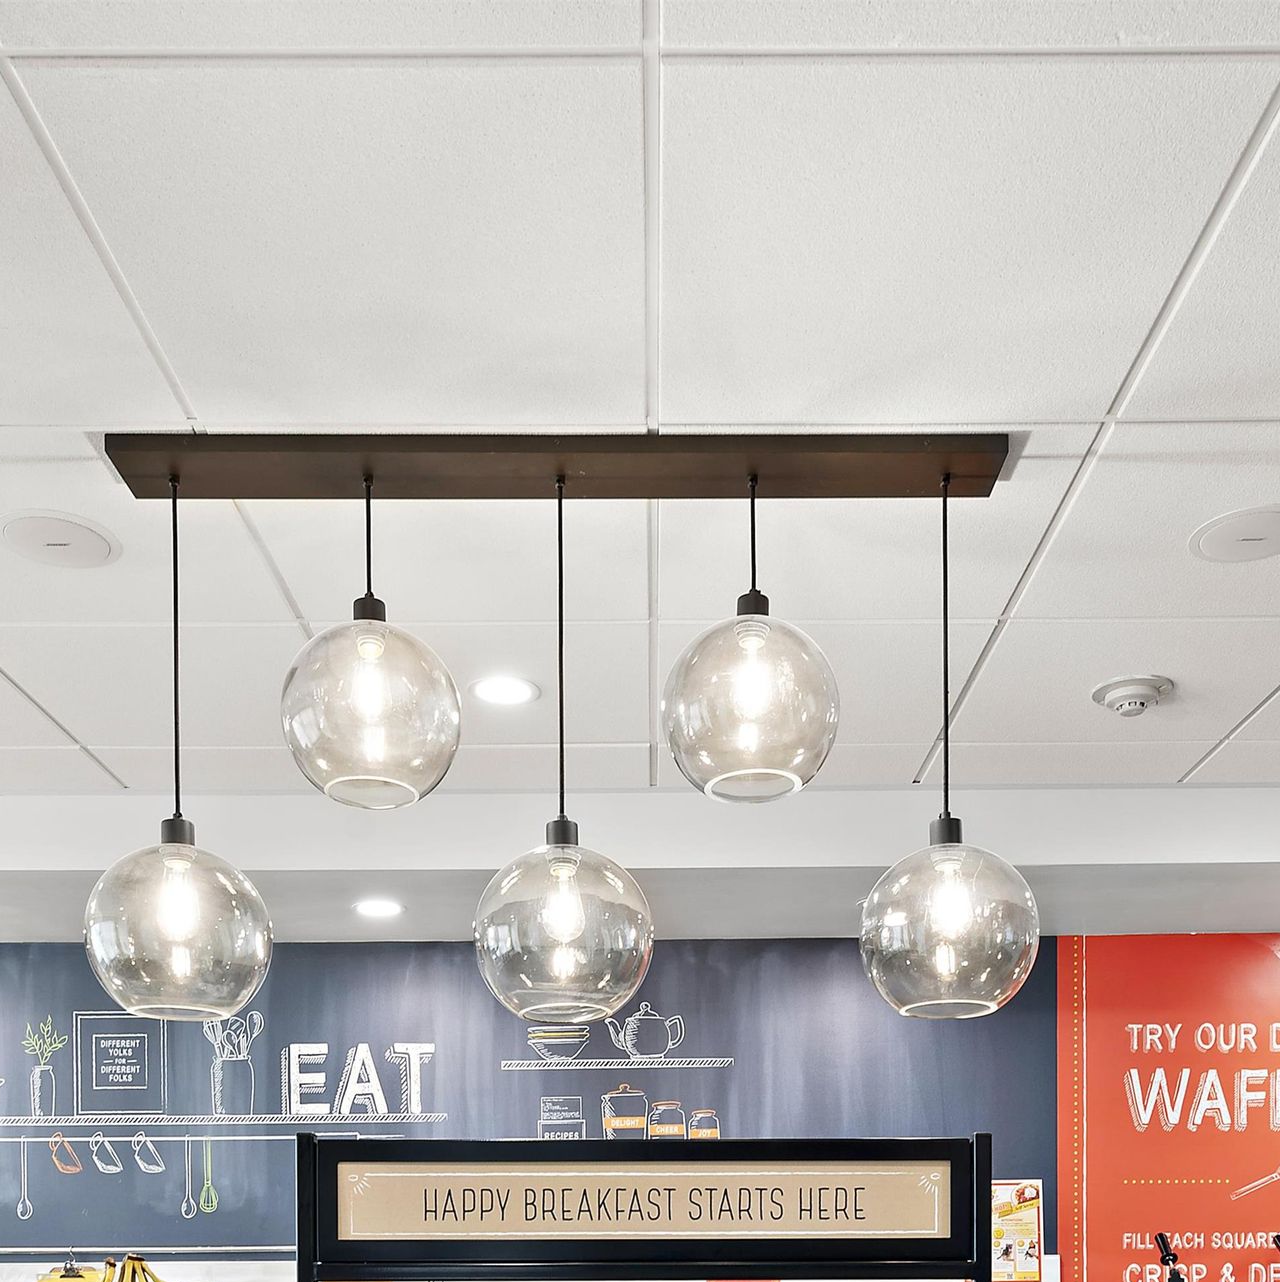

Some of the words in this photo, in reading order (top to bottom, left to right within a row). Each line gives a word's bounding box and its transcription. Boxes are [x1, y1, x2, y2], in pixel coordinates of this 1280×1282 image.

[1125, 1023, 1182, 1053] TRY
[1194, 1022, 1258, 1053] OUR
[100, 1039, 141, 1048] DIFFERENT
[108, 1048, 133, 1057] YOLKS
[100, 1065, 141, 1074] DIFFERENT
[108, 1074, 133, 1082] FOLKS
[280, 1043, 436, 1115] EAT
[610, 1120, 640, 1128] DELIGHT
[655, 1125, 679, 1134] CHEER
[698, 1129, 713, 1137] JOY
[543, 1131, 580, 1140] RECIPES
[423, 1188, 511, 1222] HAPPY
[523, 1187, 677, 1221] BREAKFAST
[687, 1187, 785, 1221] STARTS
[798, 1186, 866, 1221] HERE
[1122, 1232, 1155, 1249] FILL
